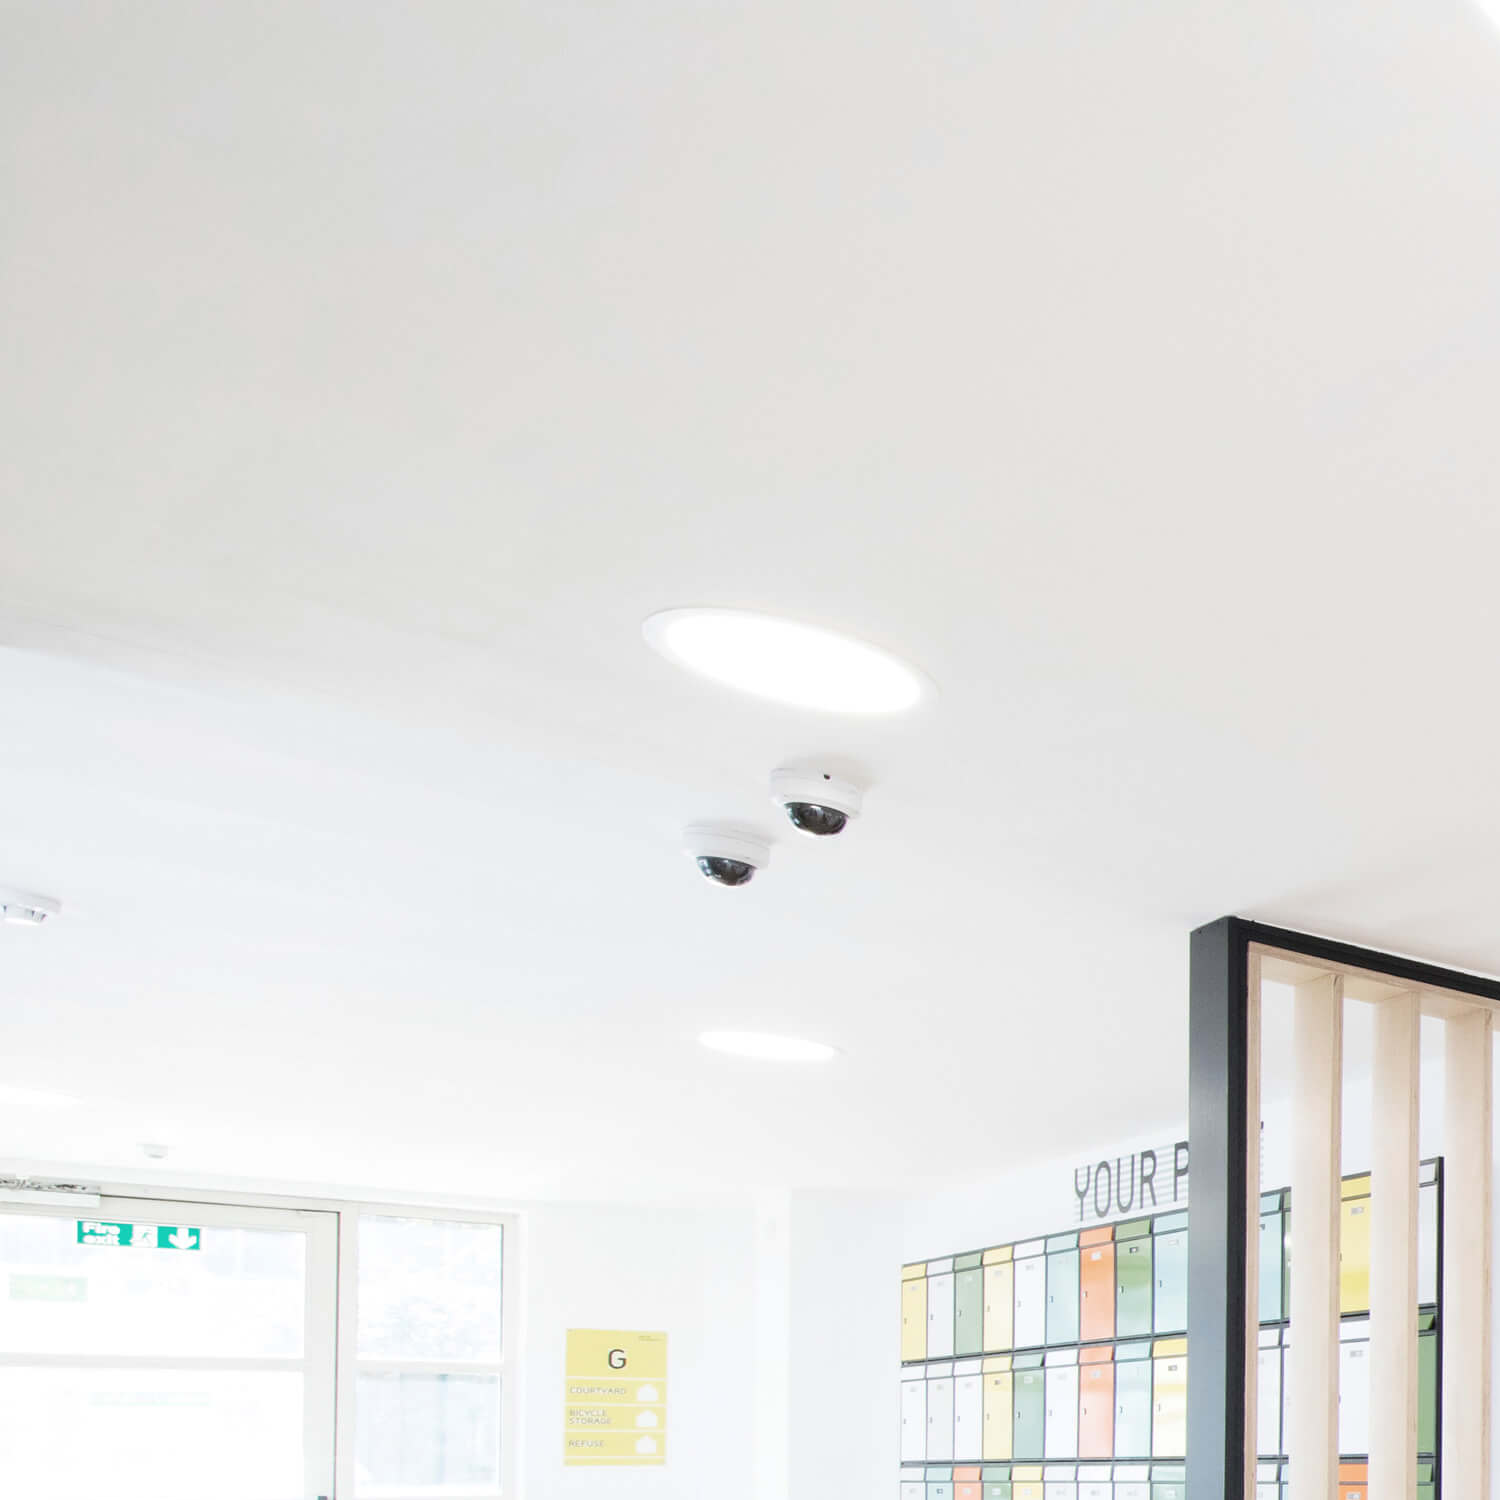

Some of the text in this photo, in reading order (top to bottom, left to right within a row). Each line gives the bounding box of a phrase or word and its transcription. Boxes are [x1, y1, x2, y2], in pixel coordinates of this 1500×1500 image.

[1074, 1149, 1157, 1222] YOUR
[82, 1221, 121, 1236] Fire
[608, 1349, 627, 1369] G
[569, 1386, 627, 1396] COURTYARD
[569, 1409, 608, 1417] BICYCLE
[568, 1417, 612, 1425] STORAGE
[568, 1440, 605, 1448] REFUSE
